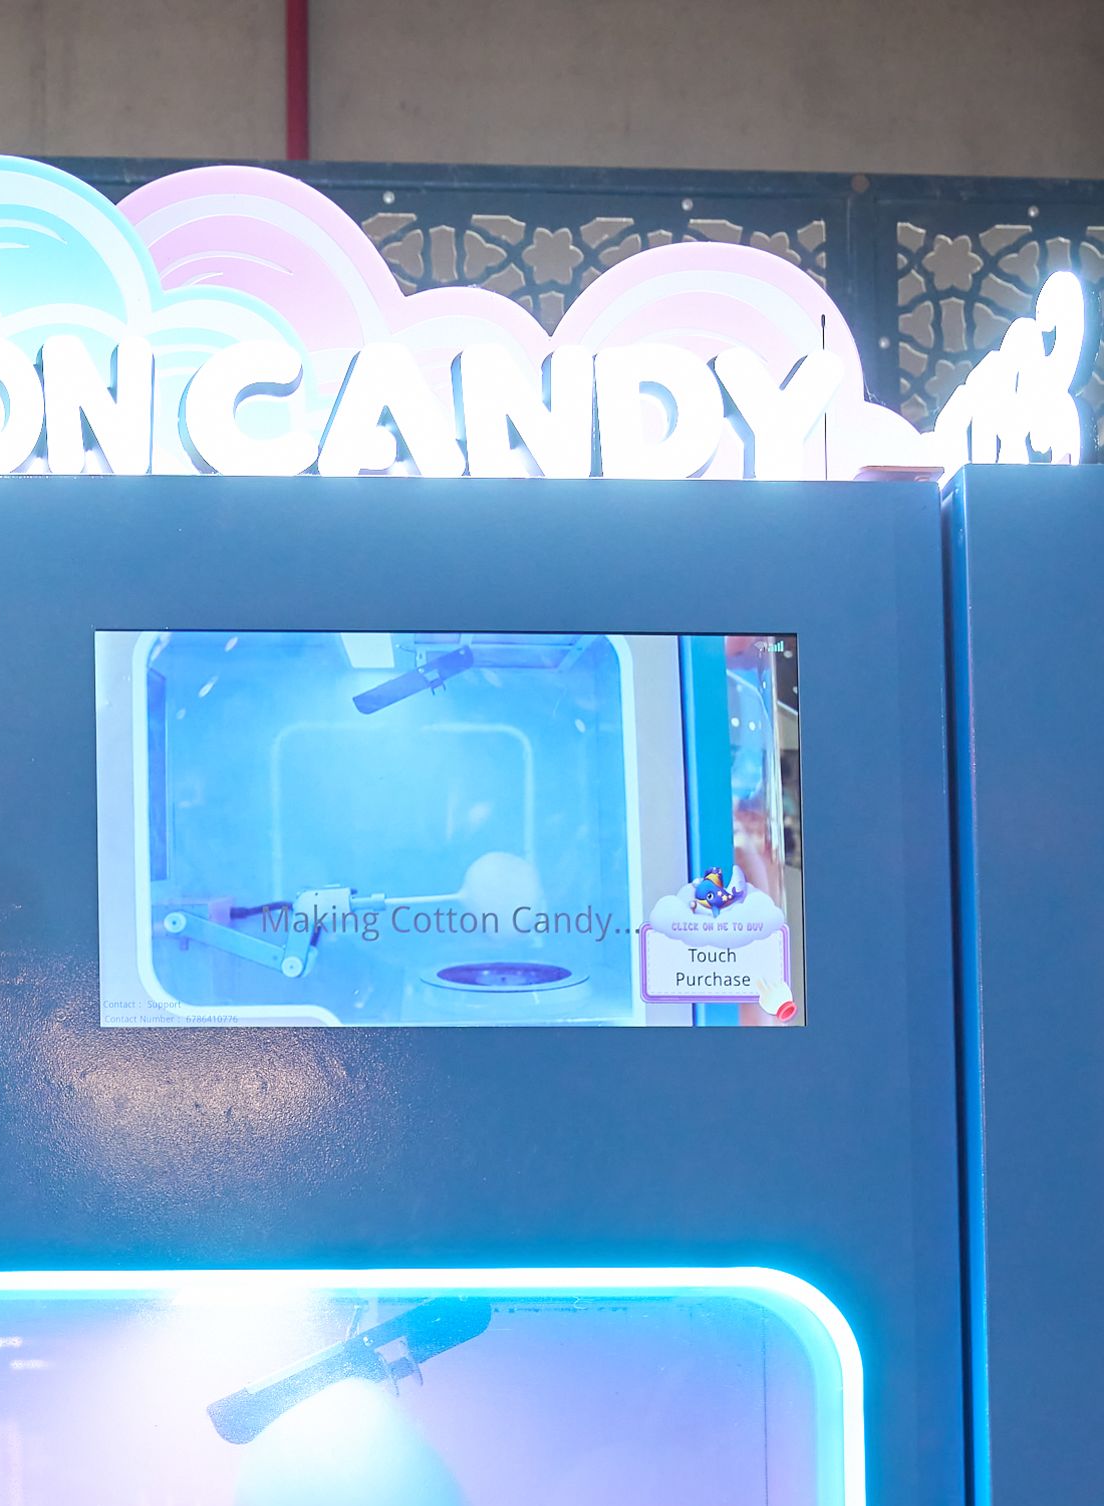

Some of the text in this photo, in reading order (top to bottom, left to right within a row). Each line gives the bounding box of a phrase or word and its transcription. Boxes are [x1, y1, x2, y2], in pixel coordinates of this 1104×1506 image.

[177, 341, 845, 478] CANDY
[261, 904, 641, 942] Making Cotton Candy...
[671, 922, 764, 932] CLICK ON ME TO BUY
[687, 948, 737, 963] Touch
[675, 972, 751, 987] Purchase
[146, 1000, 182, 1012] Support
